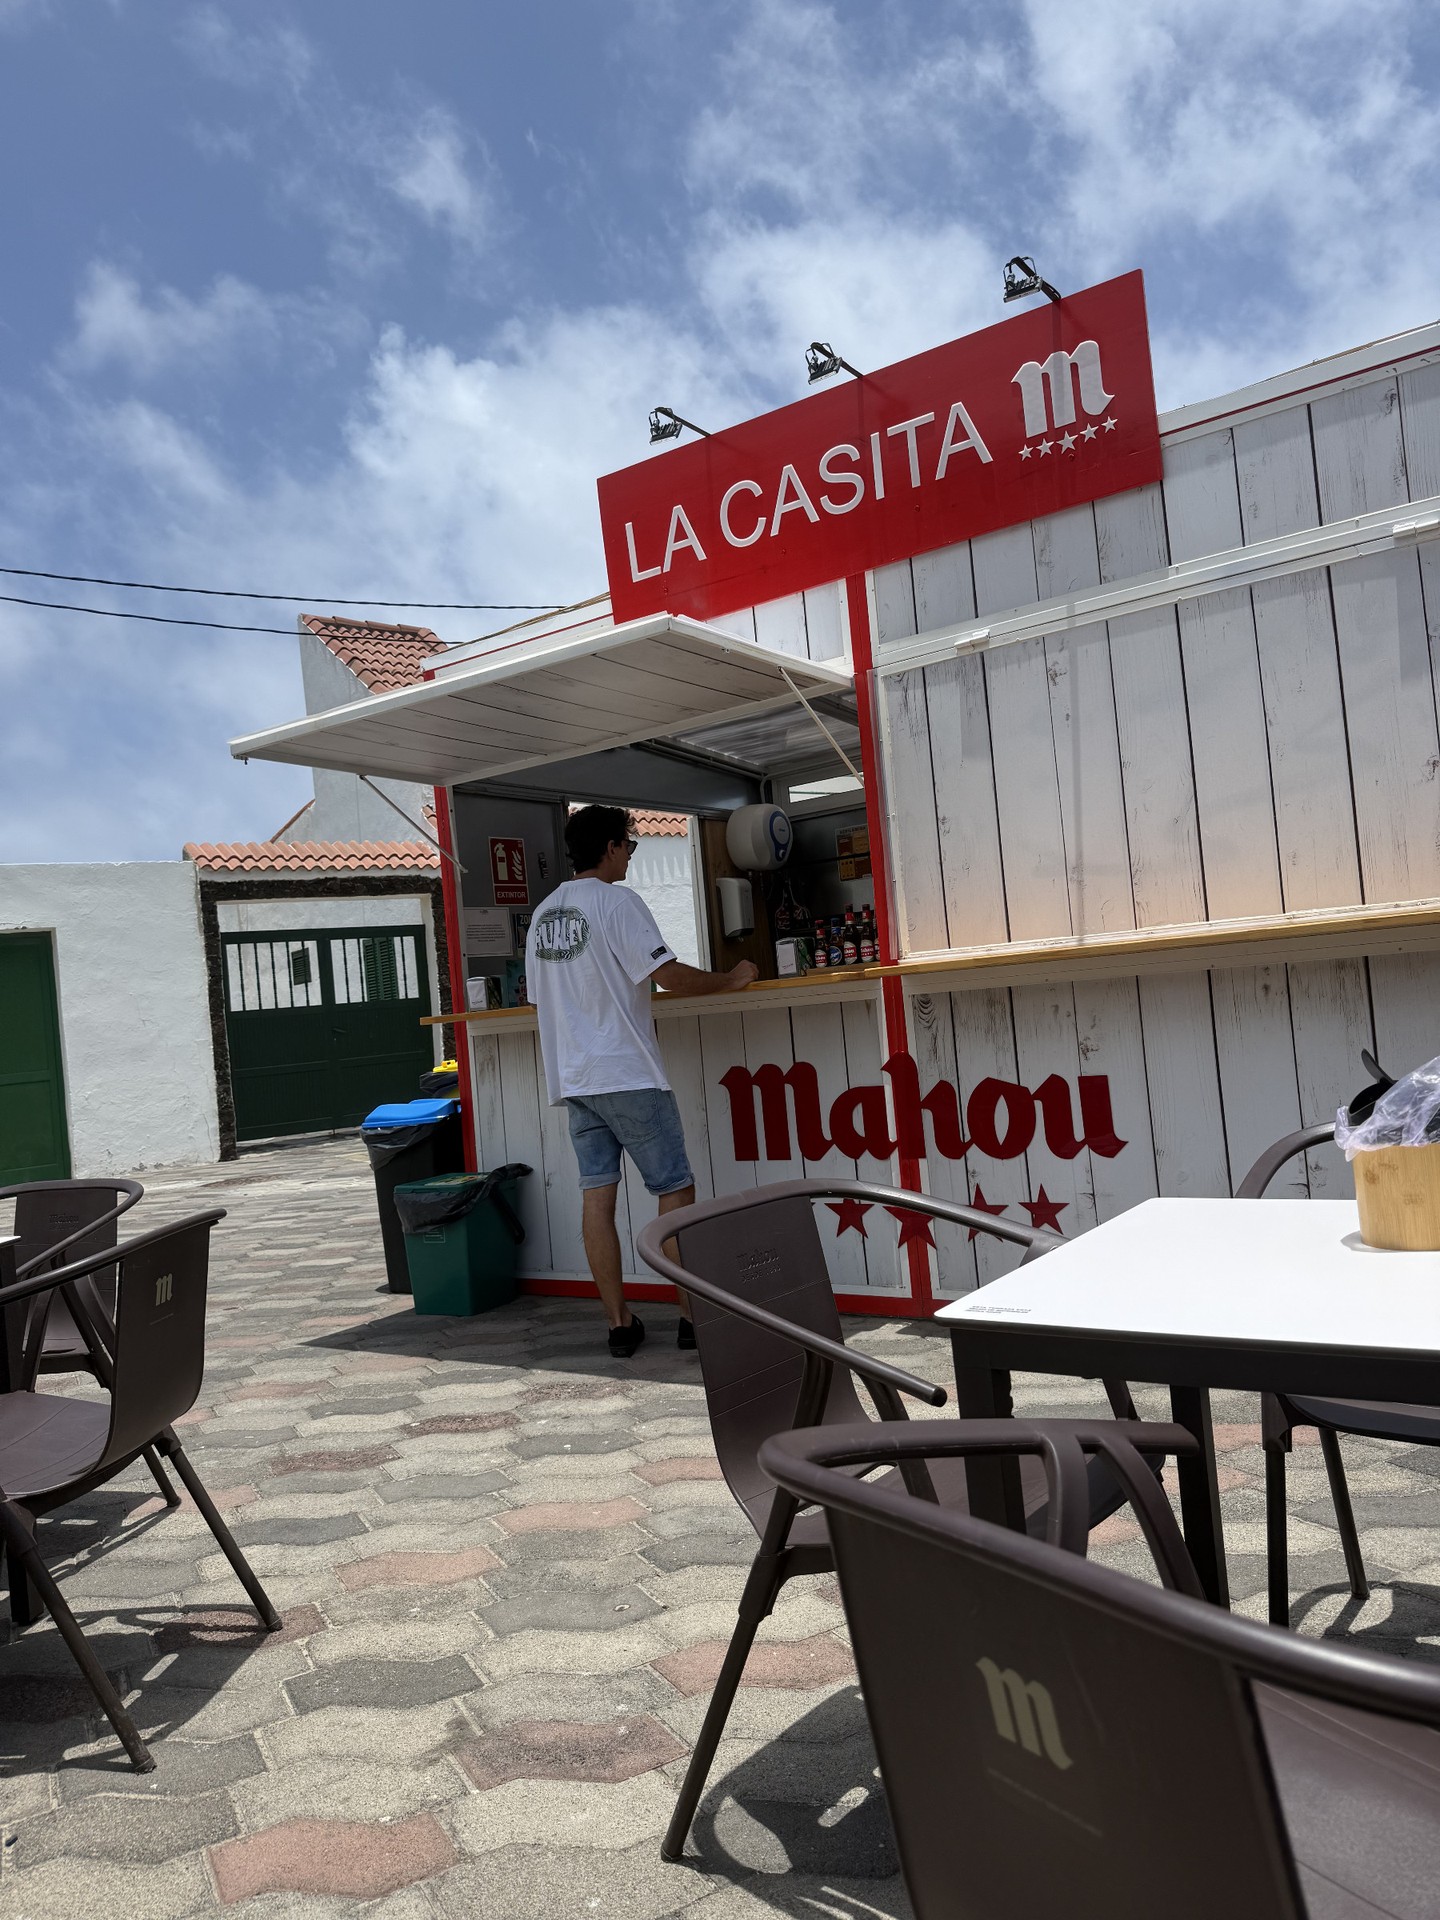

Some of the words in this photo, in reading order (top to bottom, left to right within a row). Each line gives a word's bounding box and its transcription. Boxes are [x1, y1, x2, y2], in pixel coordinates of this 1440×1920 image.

[625, 505, 707, 583] LA
[719, 401, 993, 549] CASITA
[496, 891, 526, 899] EXTINTOR
